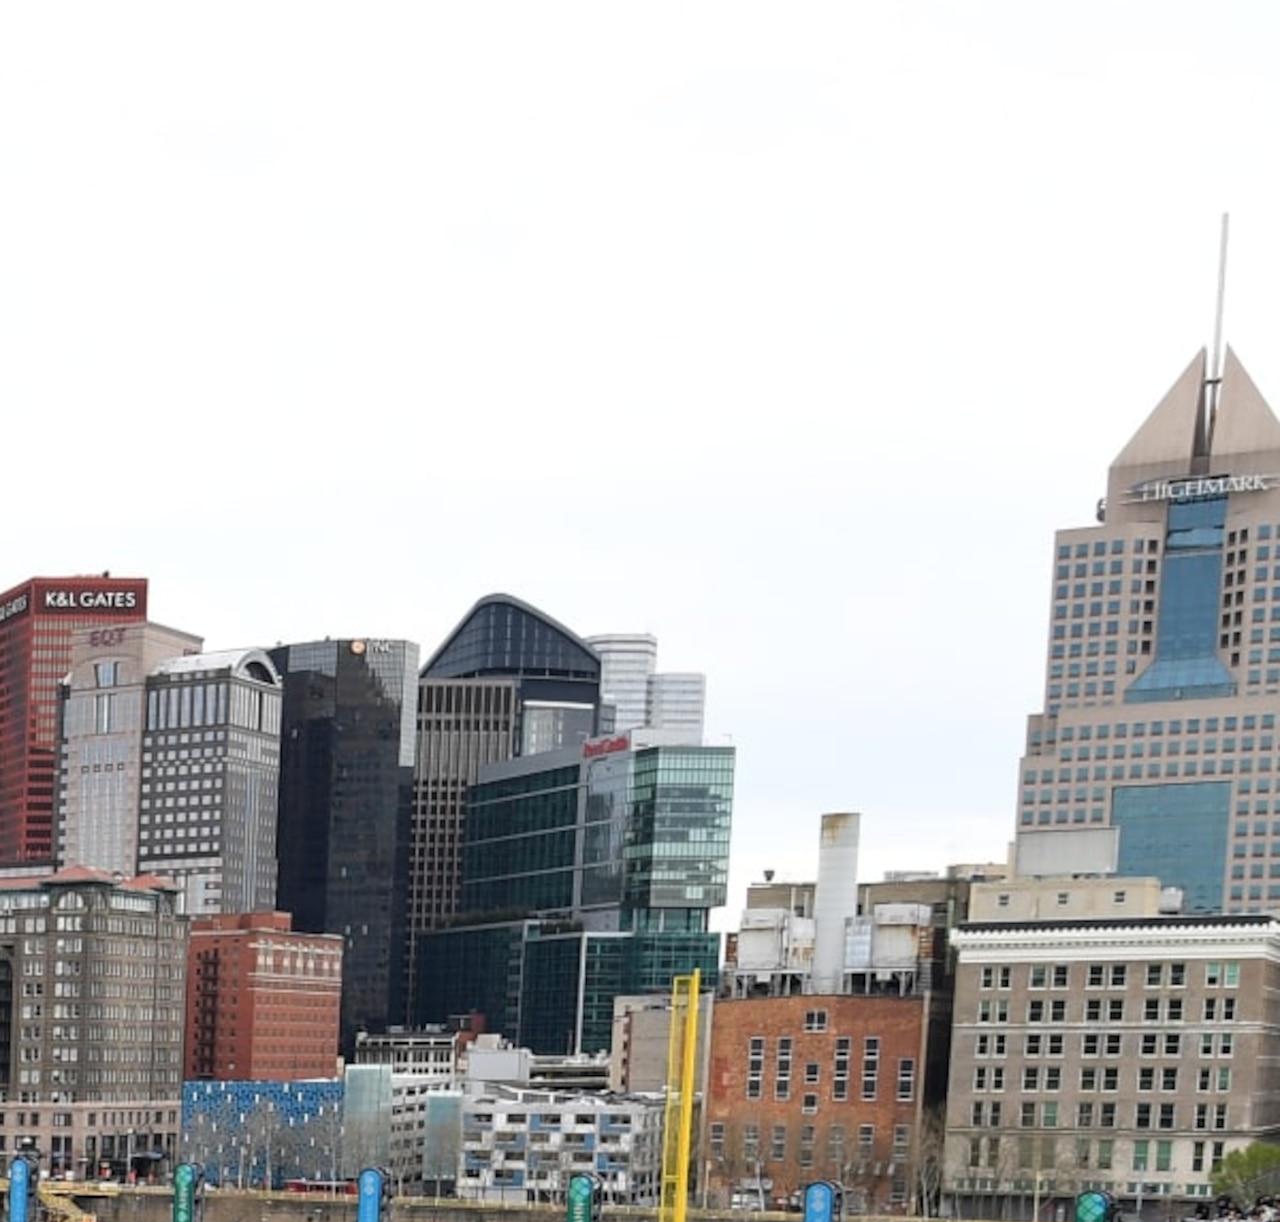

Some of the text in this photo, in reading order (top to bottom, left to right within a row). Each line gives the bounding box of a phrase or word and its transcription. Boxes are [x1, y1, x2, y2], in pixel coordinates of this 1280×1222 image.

[1141, 475, 1269, 501] HIGHMARK
[45, 590, 136, 608] K&L GATES
[90, 628, 126, 646] EQT
